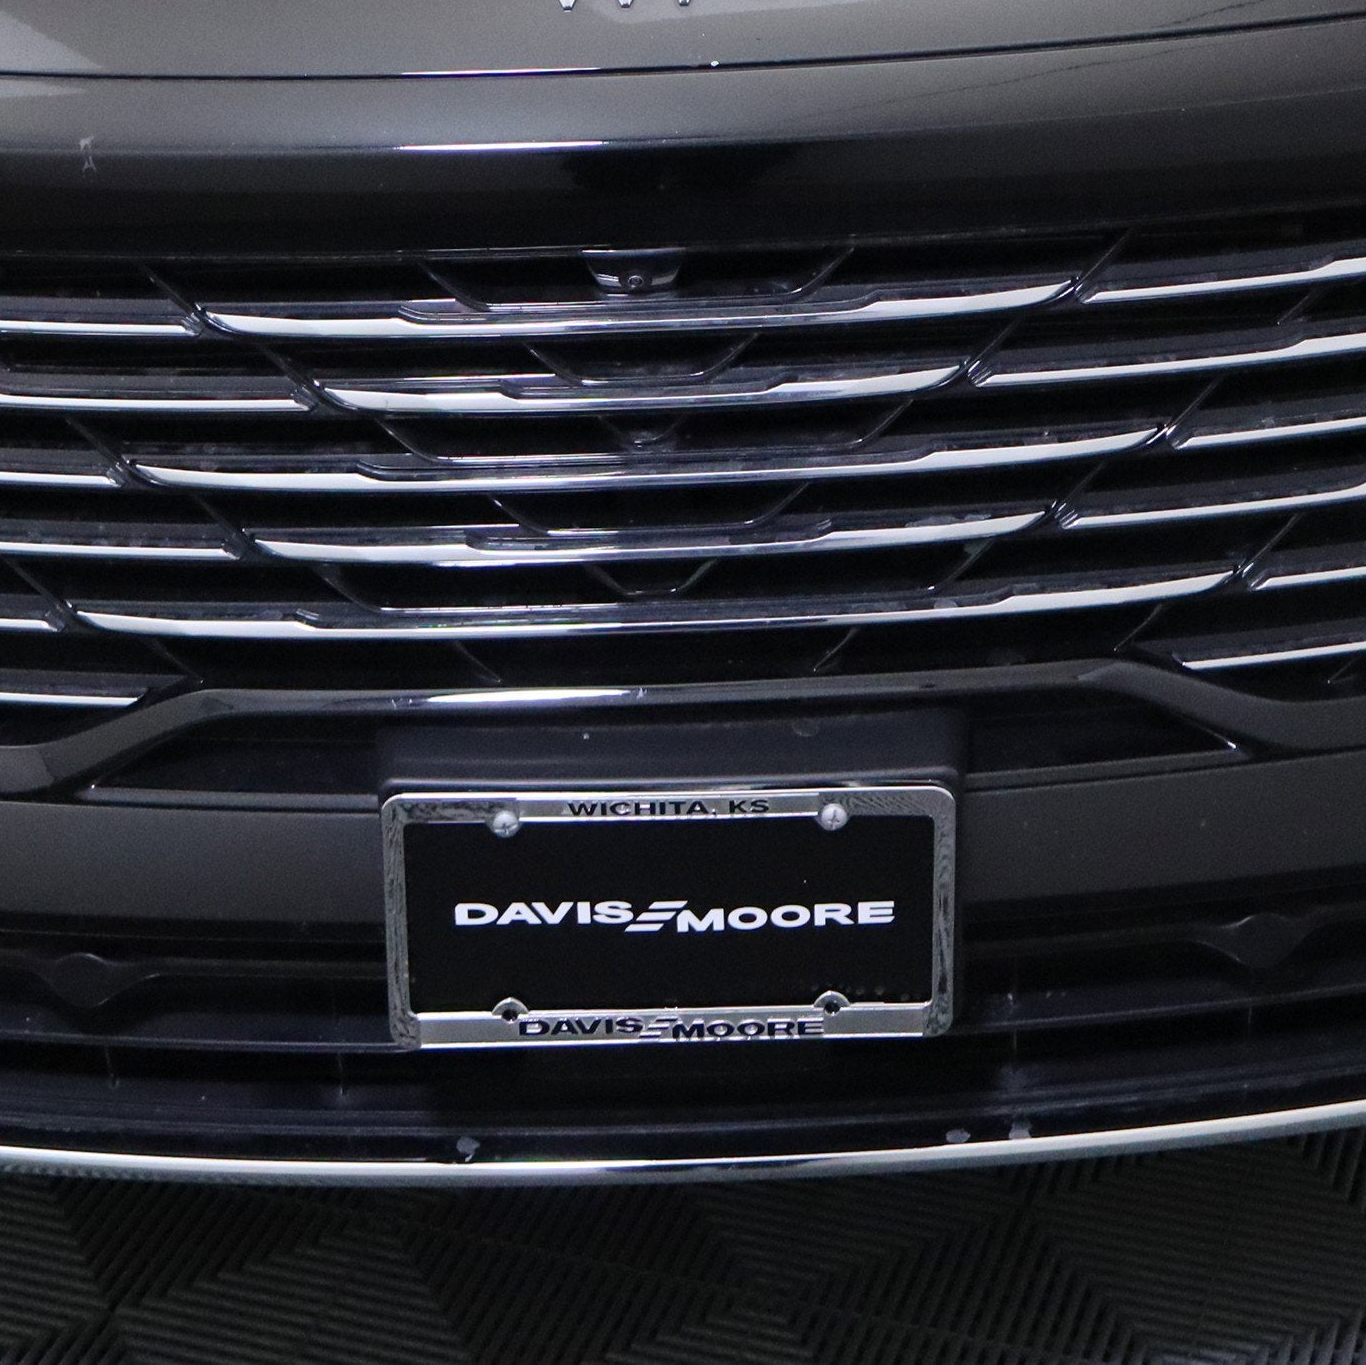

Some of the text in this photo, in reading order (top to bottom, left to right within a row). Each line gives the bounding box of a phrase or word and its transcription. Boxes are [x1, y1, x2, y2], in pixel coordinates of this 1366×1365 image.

[729, 800, 770, 813] KS
[454, 900, 895, 932] DAVIS MOORE
[519, 1017, 825, 1039] DAVIS MOORE
